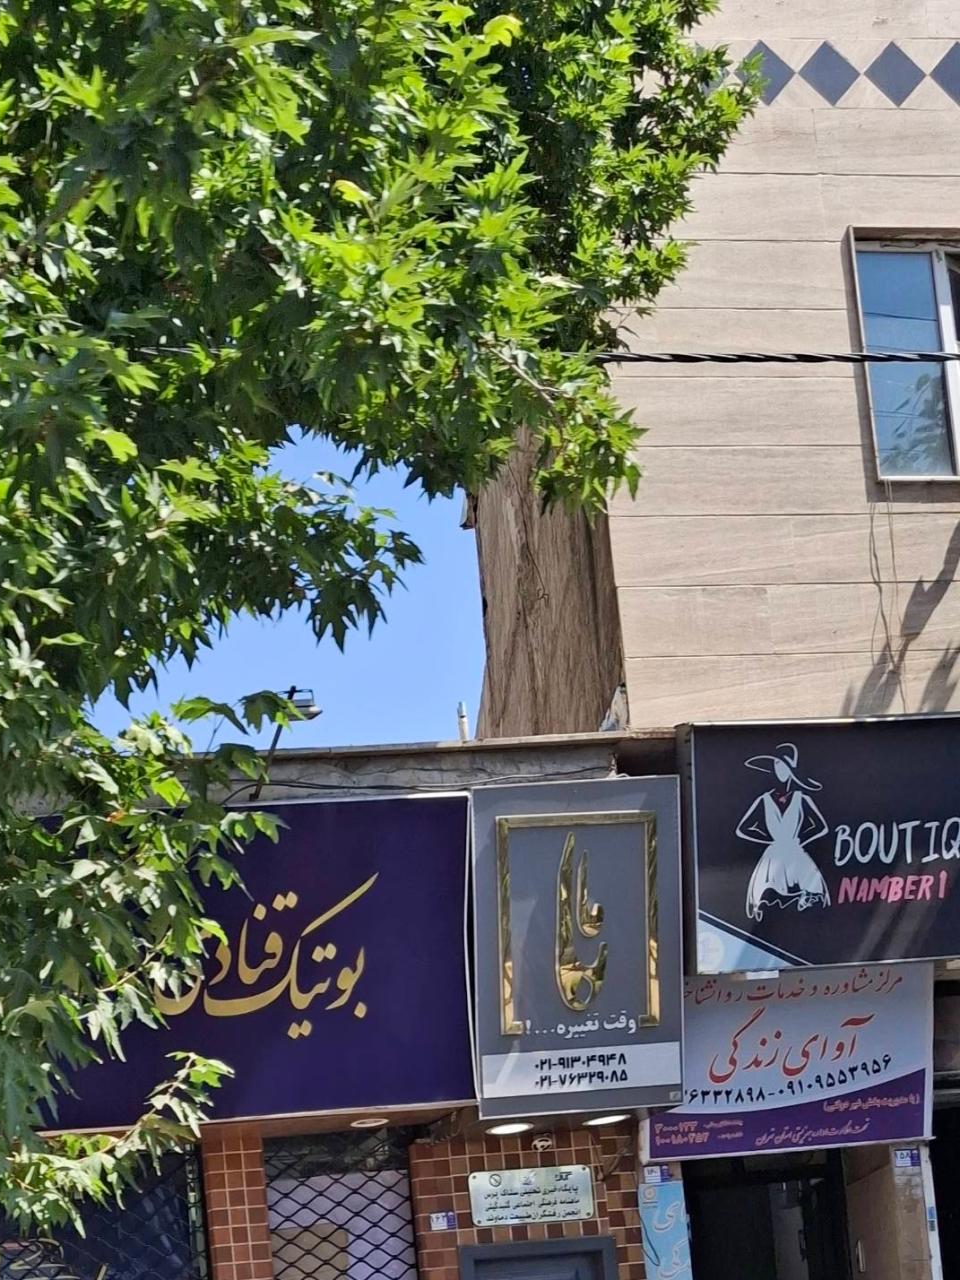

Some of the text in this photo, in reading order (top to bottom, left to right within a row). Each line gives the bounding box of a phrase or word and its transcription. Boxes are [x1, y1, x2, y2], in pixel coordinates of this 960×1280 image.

[834, 816, 960, 867] BOUTIQ
[202, 871, 379, 1039] بوتیک
[746, 978, 805, 1002] خدمات
[809, 982, 818, 997] و
[823, 969, 874, 996] مشاوره
[603, 1010, 638, 1034] وقت
[707, 1006, 877, 1084] آوای زندگی
